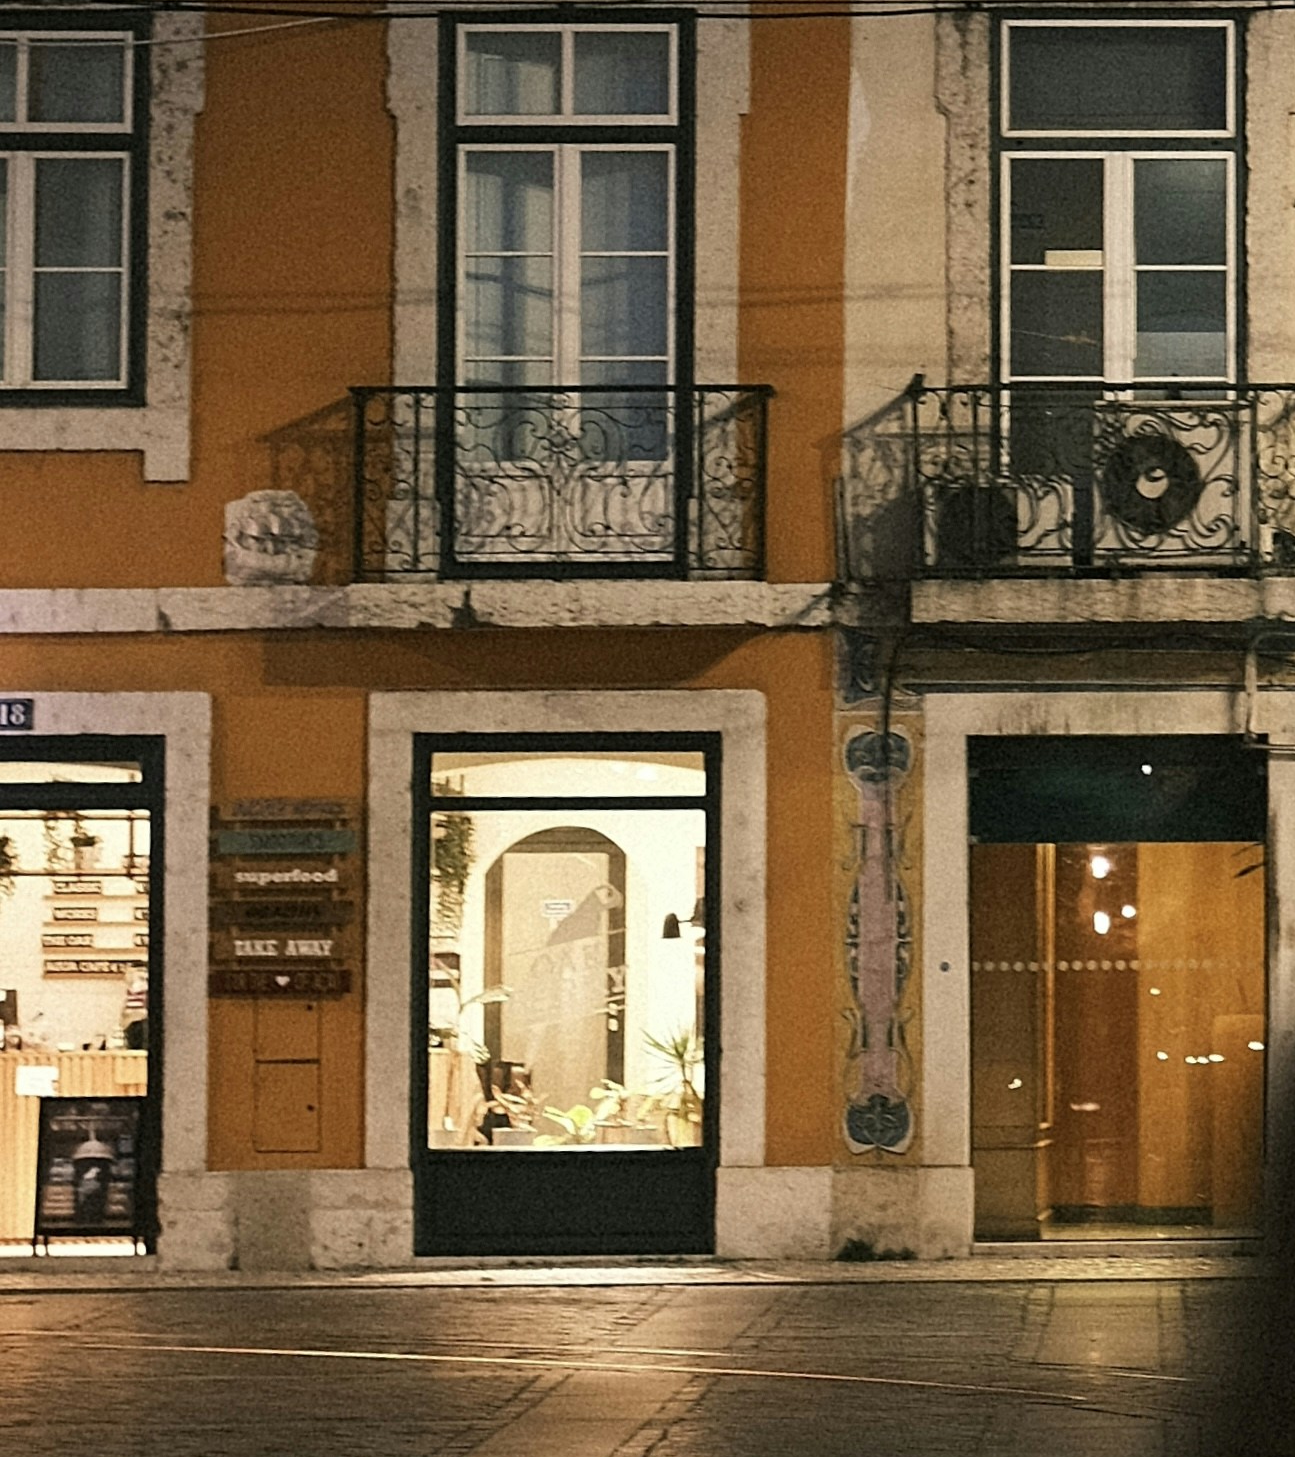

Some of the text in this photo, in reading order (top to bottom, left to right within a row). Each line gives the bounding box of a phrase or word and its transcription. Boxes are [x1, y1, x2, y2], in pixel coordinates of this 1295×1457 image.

[234, 869, 339, 886] superfood
[234, 940, 333, 956] TAKE AWAY
